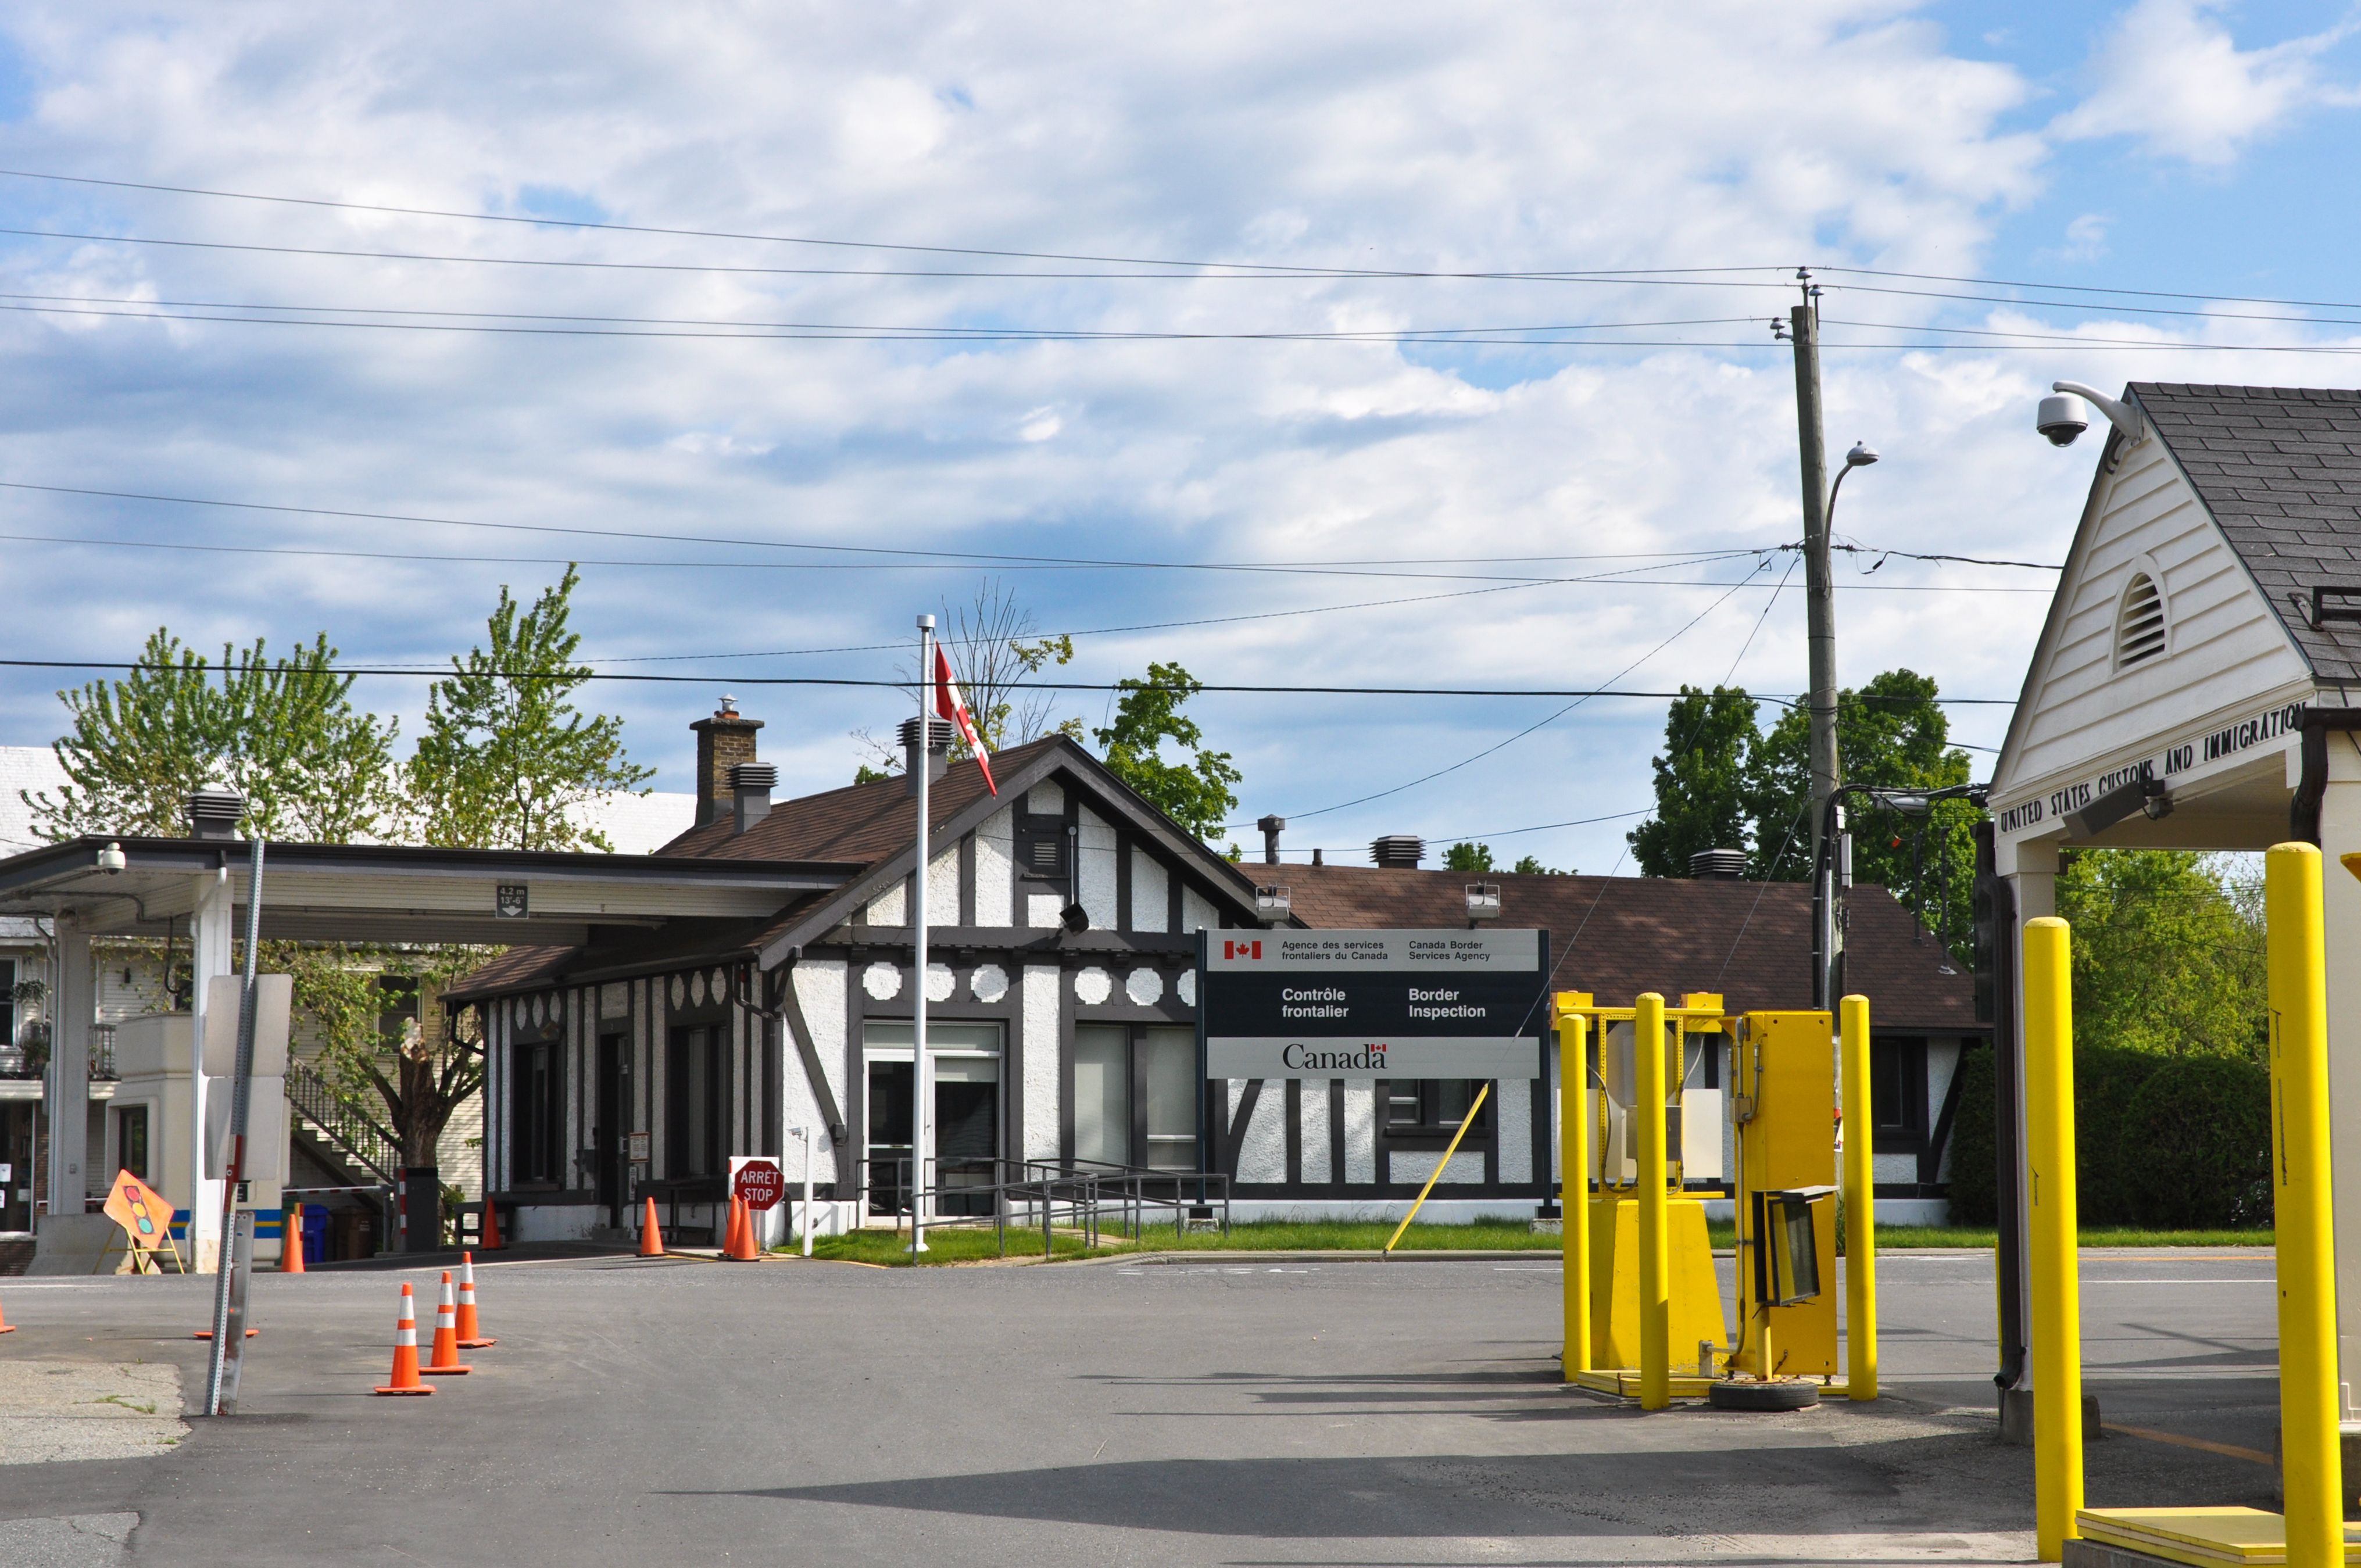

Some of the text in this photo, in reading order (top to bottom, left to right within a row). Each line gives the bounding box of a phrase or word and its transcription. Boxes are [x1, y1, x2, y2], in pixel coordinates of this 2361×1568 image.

[2001, 800, 2042, 832] UNITED
[2051, 783, 2090, 816] STATES
[2165, 744, 2193, 775] AND
[500, 887, 514, 895] 4.2
[1282, 940, 1384, 951] Agence des services
[1408, 940, 1483, 950] Canada Border
[1282, 951, 1388, 960] frontaliers du Canada
[1409, 951, 1491, 962] Services Agency
[1282, 987, 1346, 1001] Contrôle
[1409, 988, 1459, 1001] Border
[1282, 1005, 1349, 1018] frontalier
[1409, 1005, 1486, 1021] Inspection
[1282, 1043, 1387, 1069] Canada
[740, 1169, 779, 1185] ARRÊT
[744, 1187, 774, 1202] STOP
